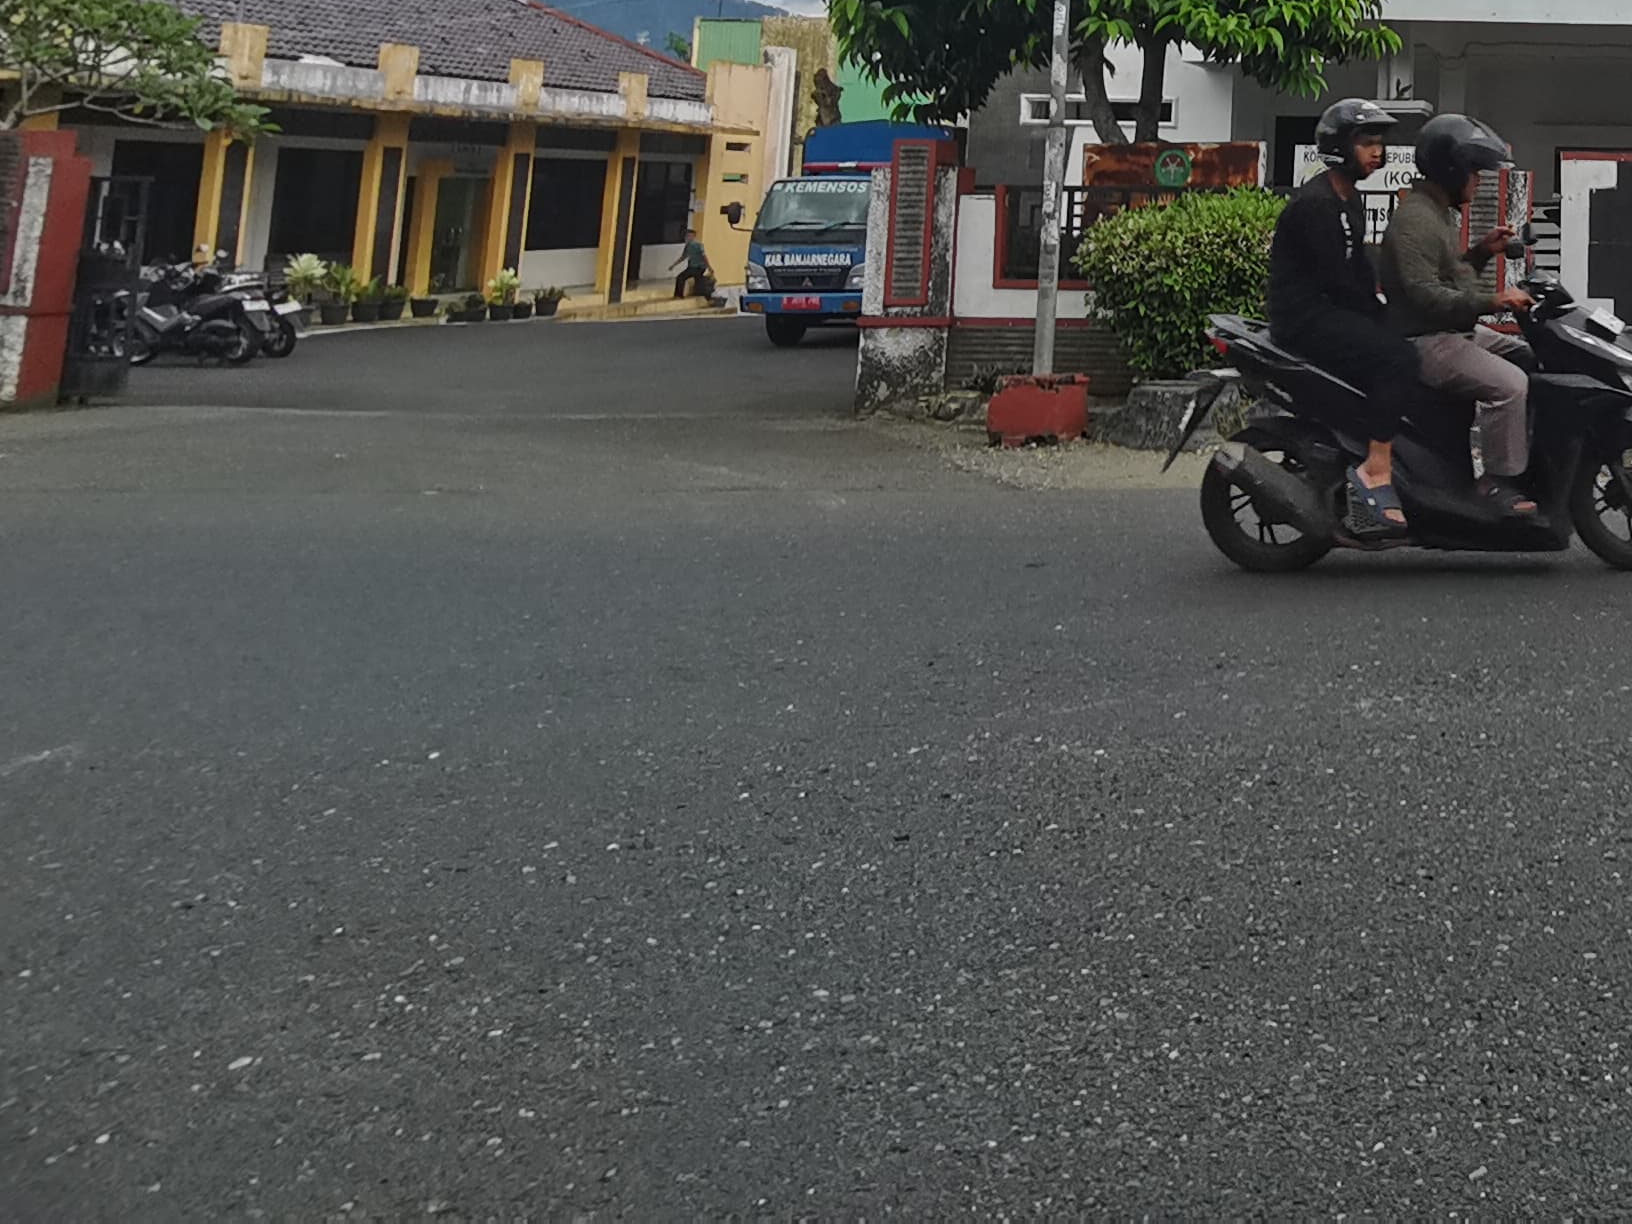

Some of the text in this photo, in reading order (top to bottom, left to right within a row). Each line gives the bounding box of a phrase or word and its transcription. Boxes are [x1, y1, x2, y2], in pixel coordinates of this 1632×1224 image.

[1386, 151, 1416, 164] EPUBL
[784, 181, 868, 194] KEMENSOS
[784, 253, 852, 266] BANJARNEGARA
